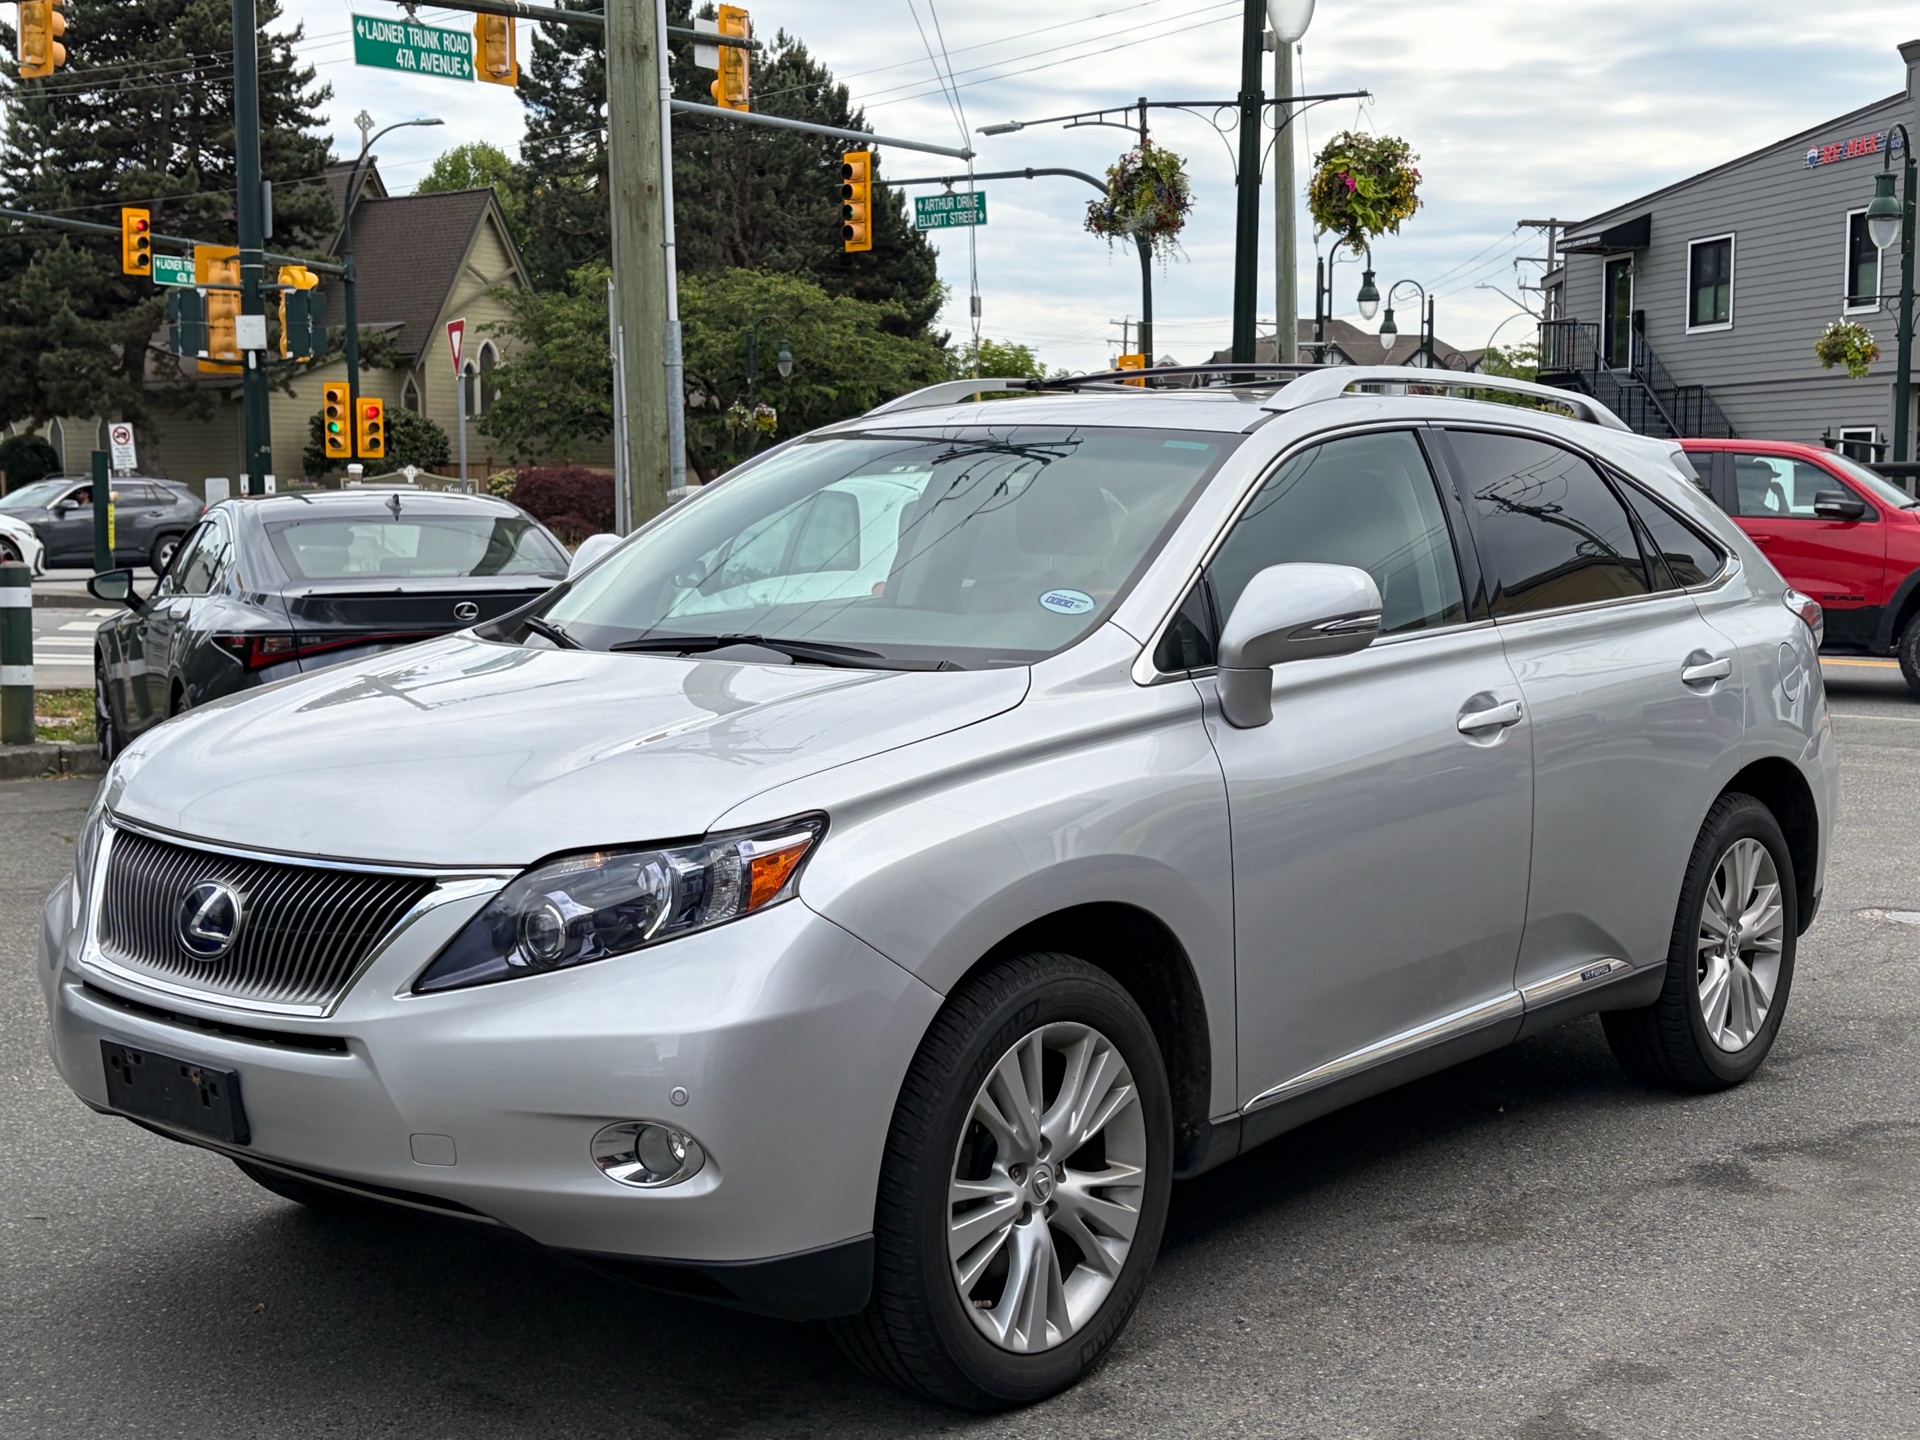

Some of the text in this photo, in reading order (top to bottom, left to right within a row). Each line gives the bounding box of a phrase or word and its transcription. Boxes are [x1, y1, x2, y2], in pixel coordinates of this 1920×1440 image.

[365, 20, 469, 55] LADNER TRUNK ROAD
[395, 48, 462, 76] 47A AVENUE
[1823, 133, 1878, 164] RE/MAX
[924, 197, 954, 211] ARTHUR
[918, 210, 977, 227] ELLIOTT STREET
[183, 260, 195, 272] TRU
[1585, 965, 1609, 979] HYBRID
